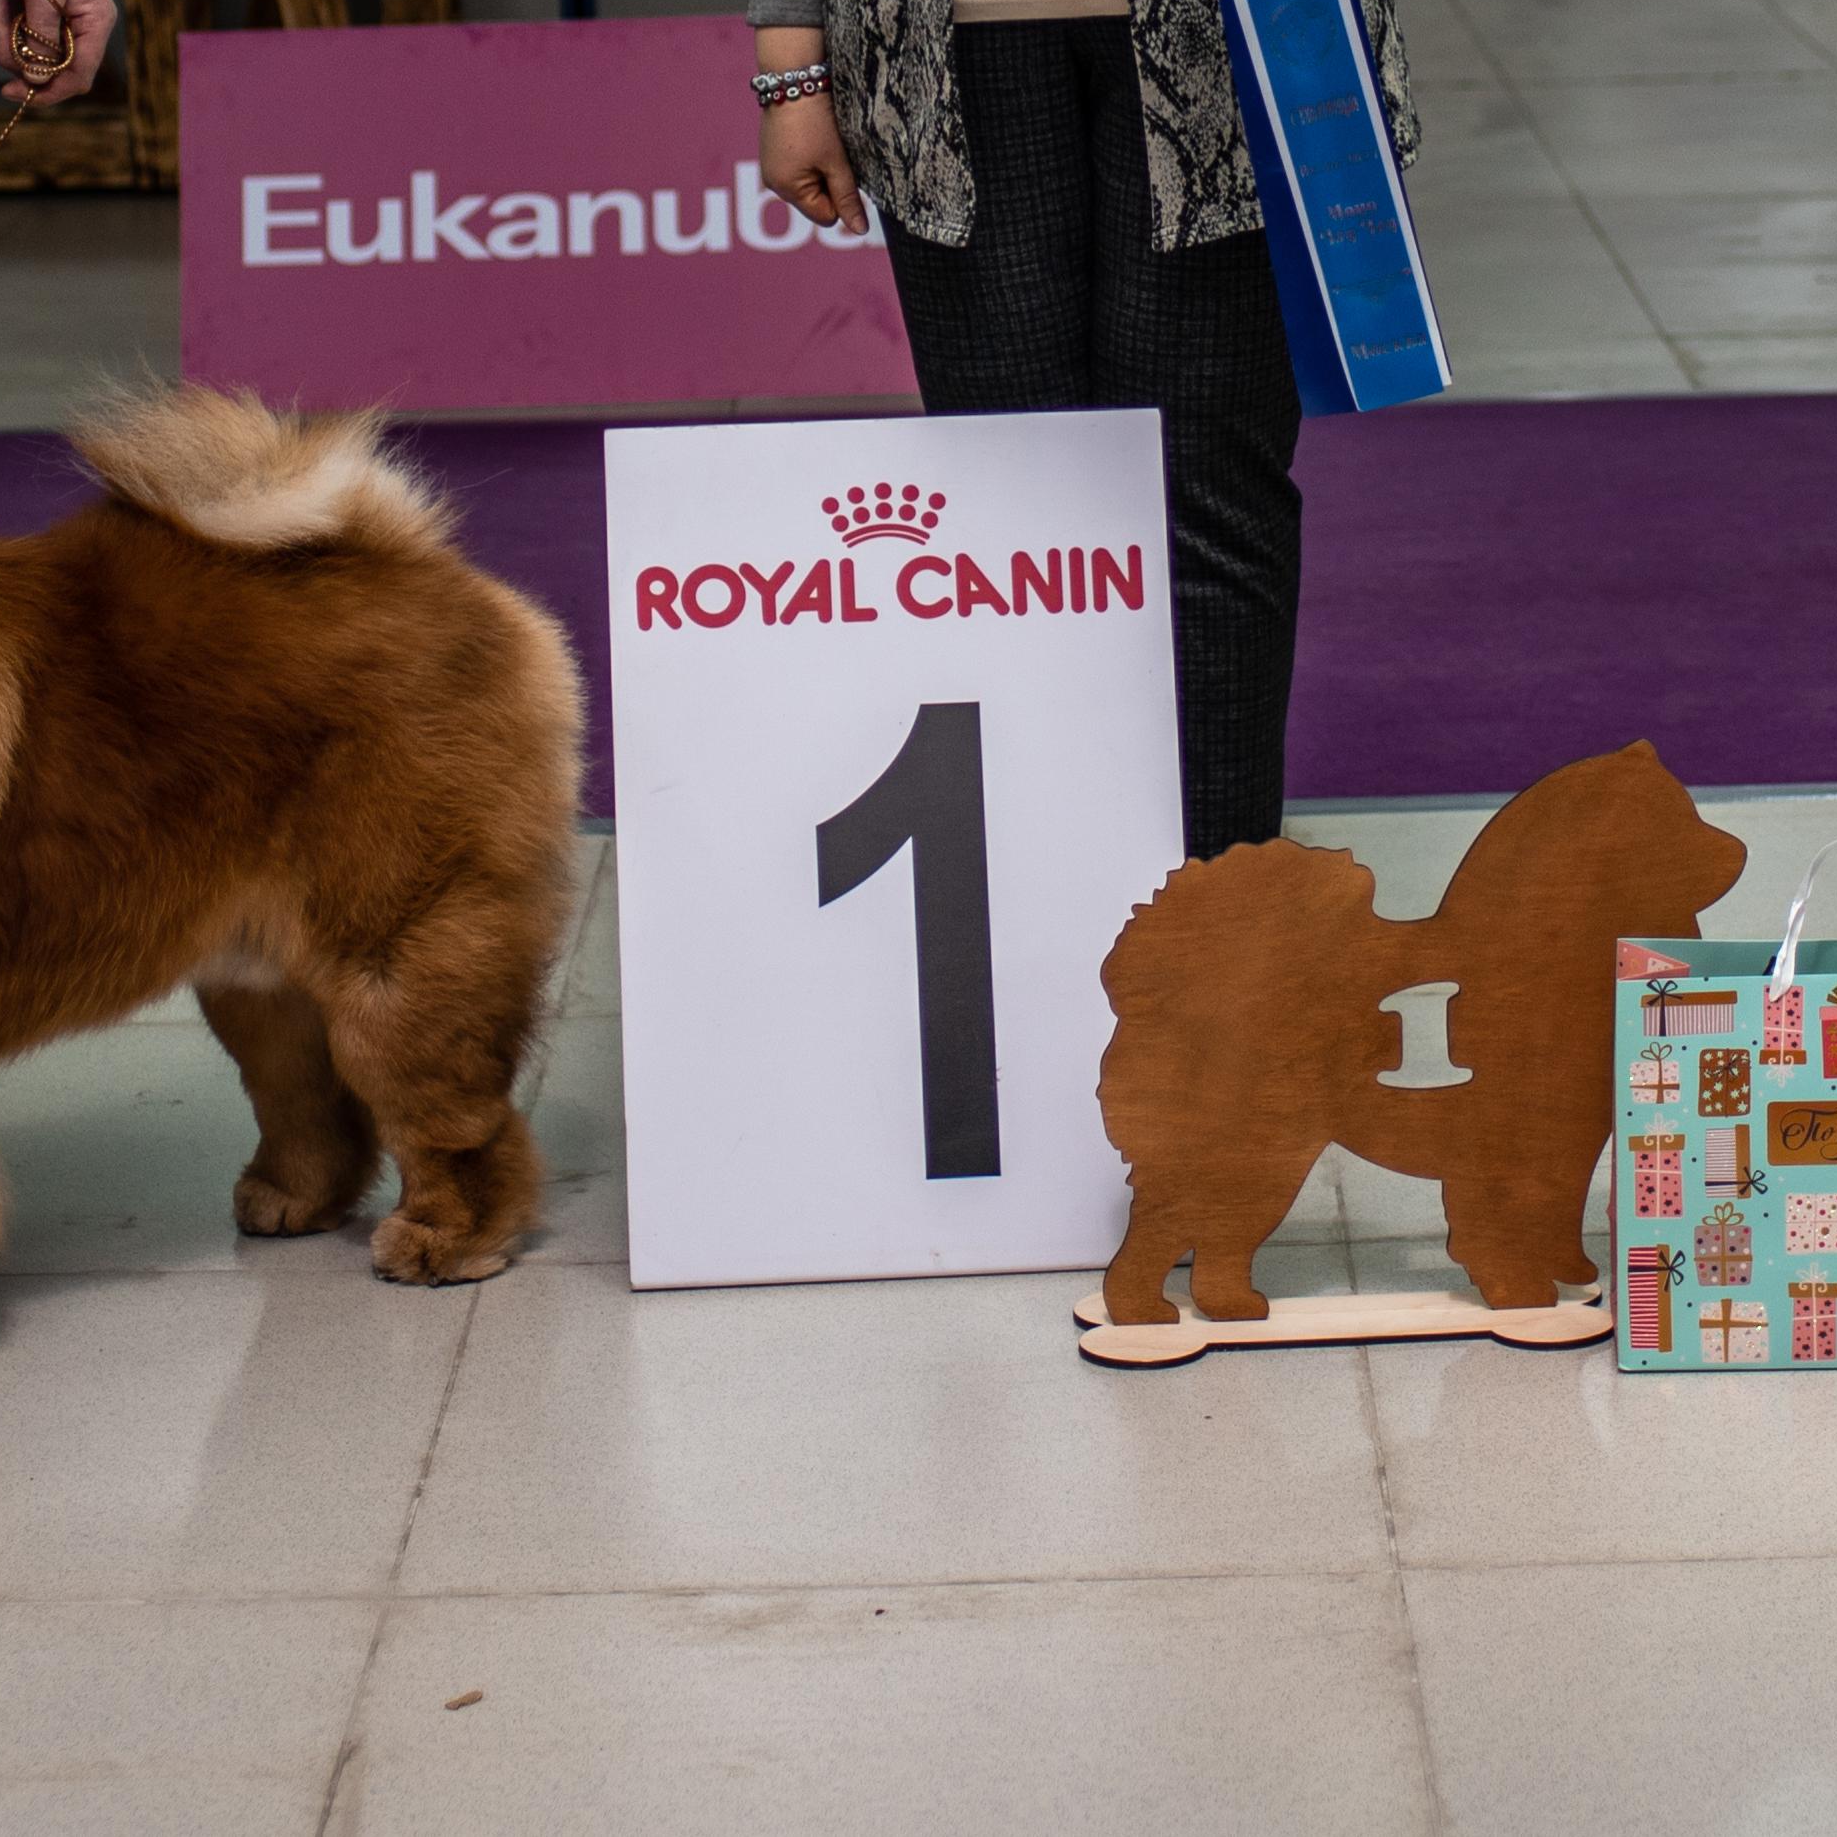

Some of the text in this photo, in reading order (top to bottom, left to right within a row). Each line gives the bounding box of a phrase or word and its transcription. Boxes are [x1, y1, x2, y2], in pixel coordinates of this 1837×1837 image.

[241, 160, 888, 268] Eukanuba
[636, 544, 1144, 631] ROYAL CANIN
[815, 701, 1002, 1180] 1
[1375, 980, 1474, 1090] 1
